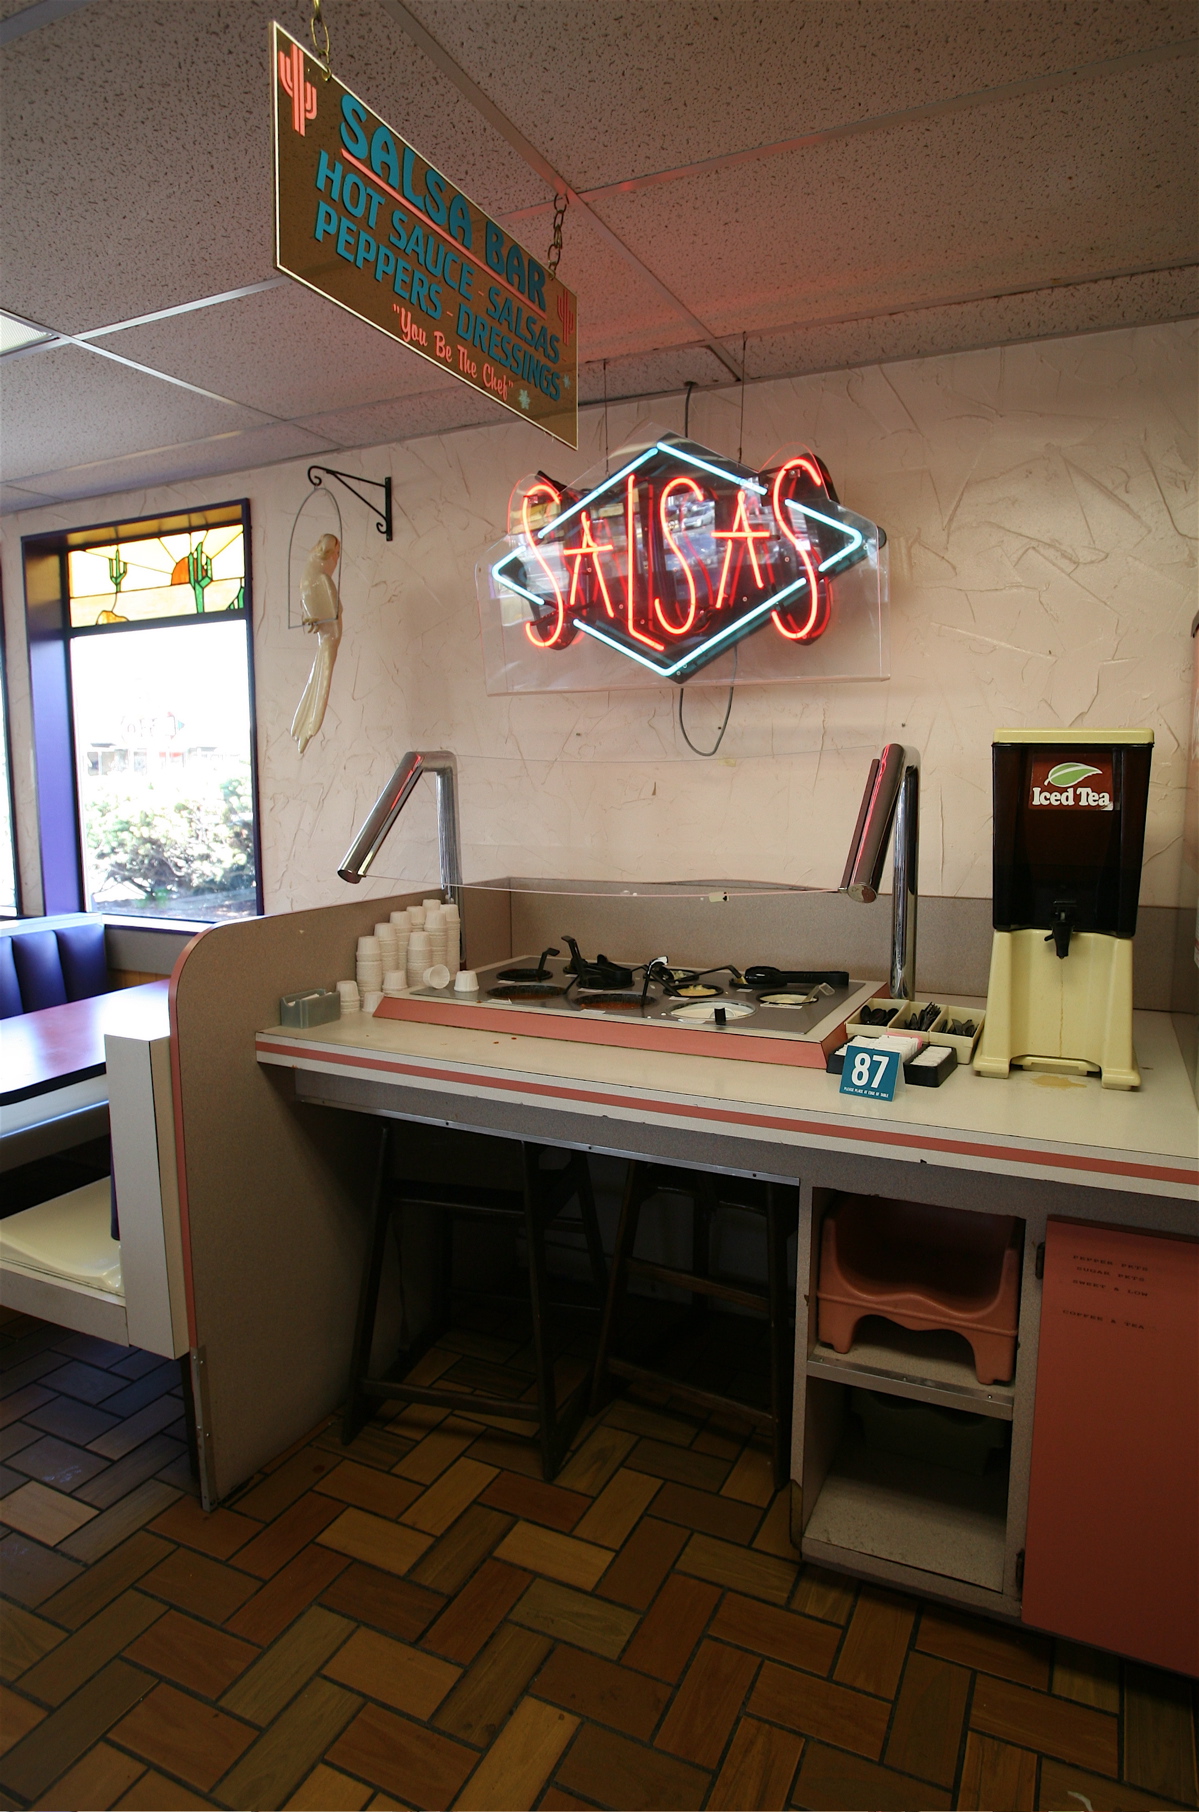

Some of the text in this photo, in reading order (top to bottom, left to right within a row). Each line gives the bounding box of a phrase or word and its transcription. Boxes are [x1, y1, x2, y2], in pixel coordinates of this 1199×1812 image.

[339, 94, 547, 312] SALSA BAR
[315, 149, 386, 230] HOT
[389, 209, 475, 300] SAUCE
[486, 286, 561, 364] SALSAS
[314, 200, 443, 320] PEPPERS
[456, 303, 561, 401] DRESSINGS
[393, 303, 514, 401] "You Be The Chef"
[522, 456, 822, 653] SALSAS
[1032, 787, 1110, 806] Iced Tea
[852, 1053, 889, 1088] 87
[1073, 1255, 1114, 1266] PEPPER
[1077, 1266, 1111, 1276] SUGAR
[1127, 1289, 1148, 1297] LOW
[1062, 1309, 1104, 1322] COFFEE
[1124, 1321, 1145, 1330] TEA
